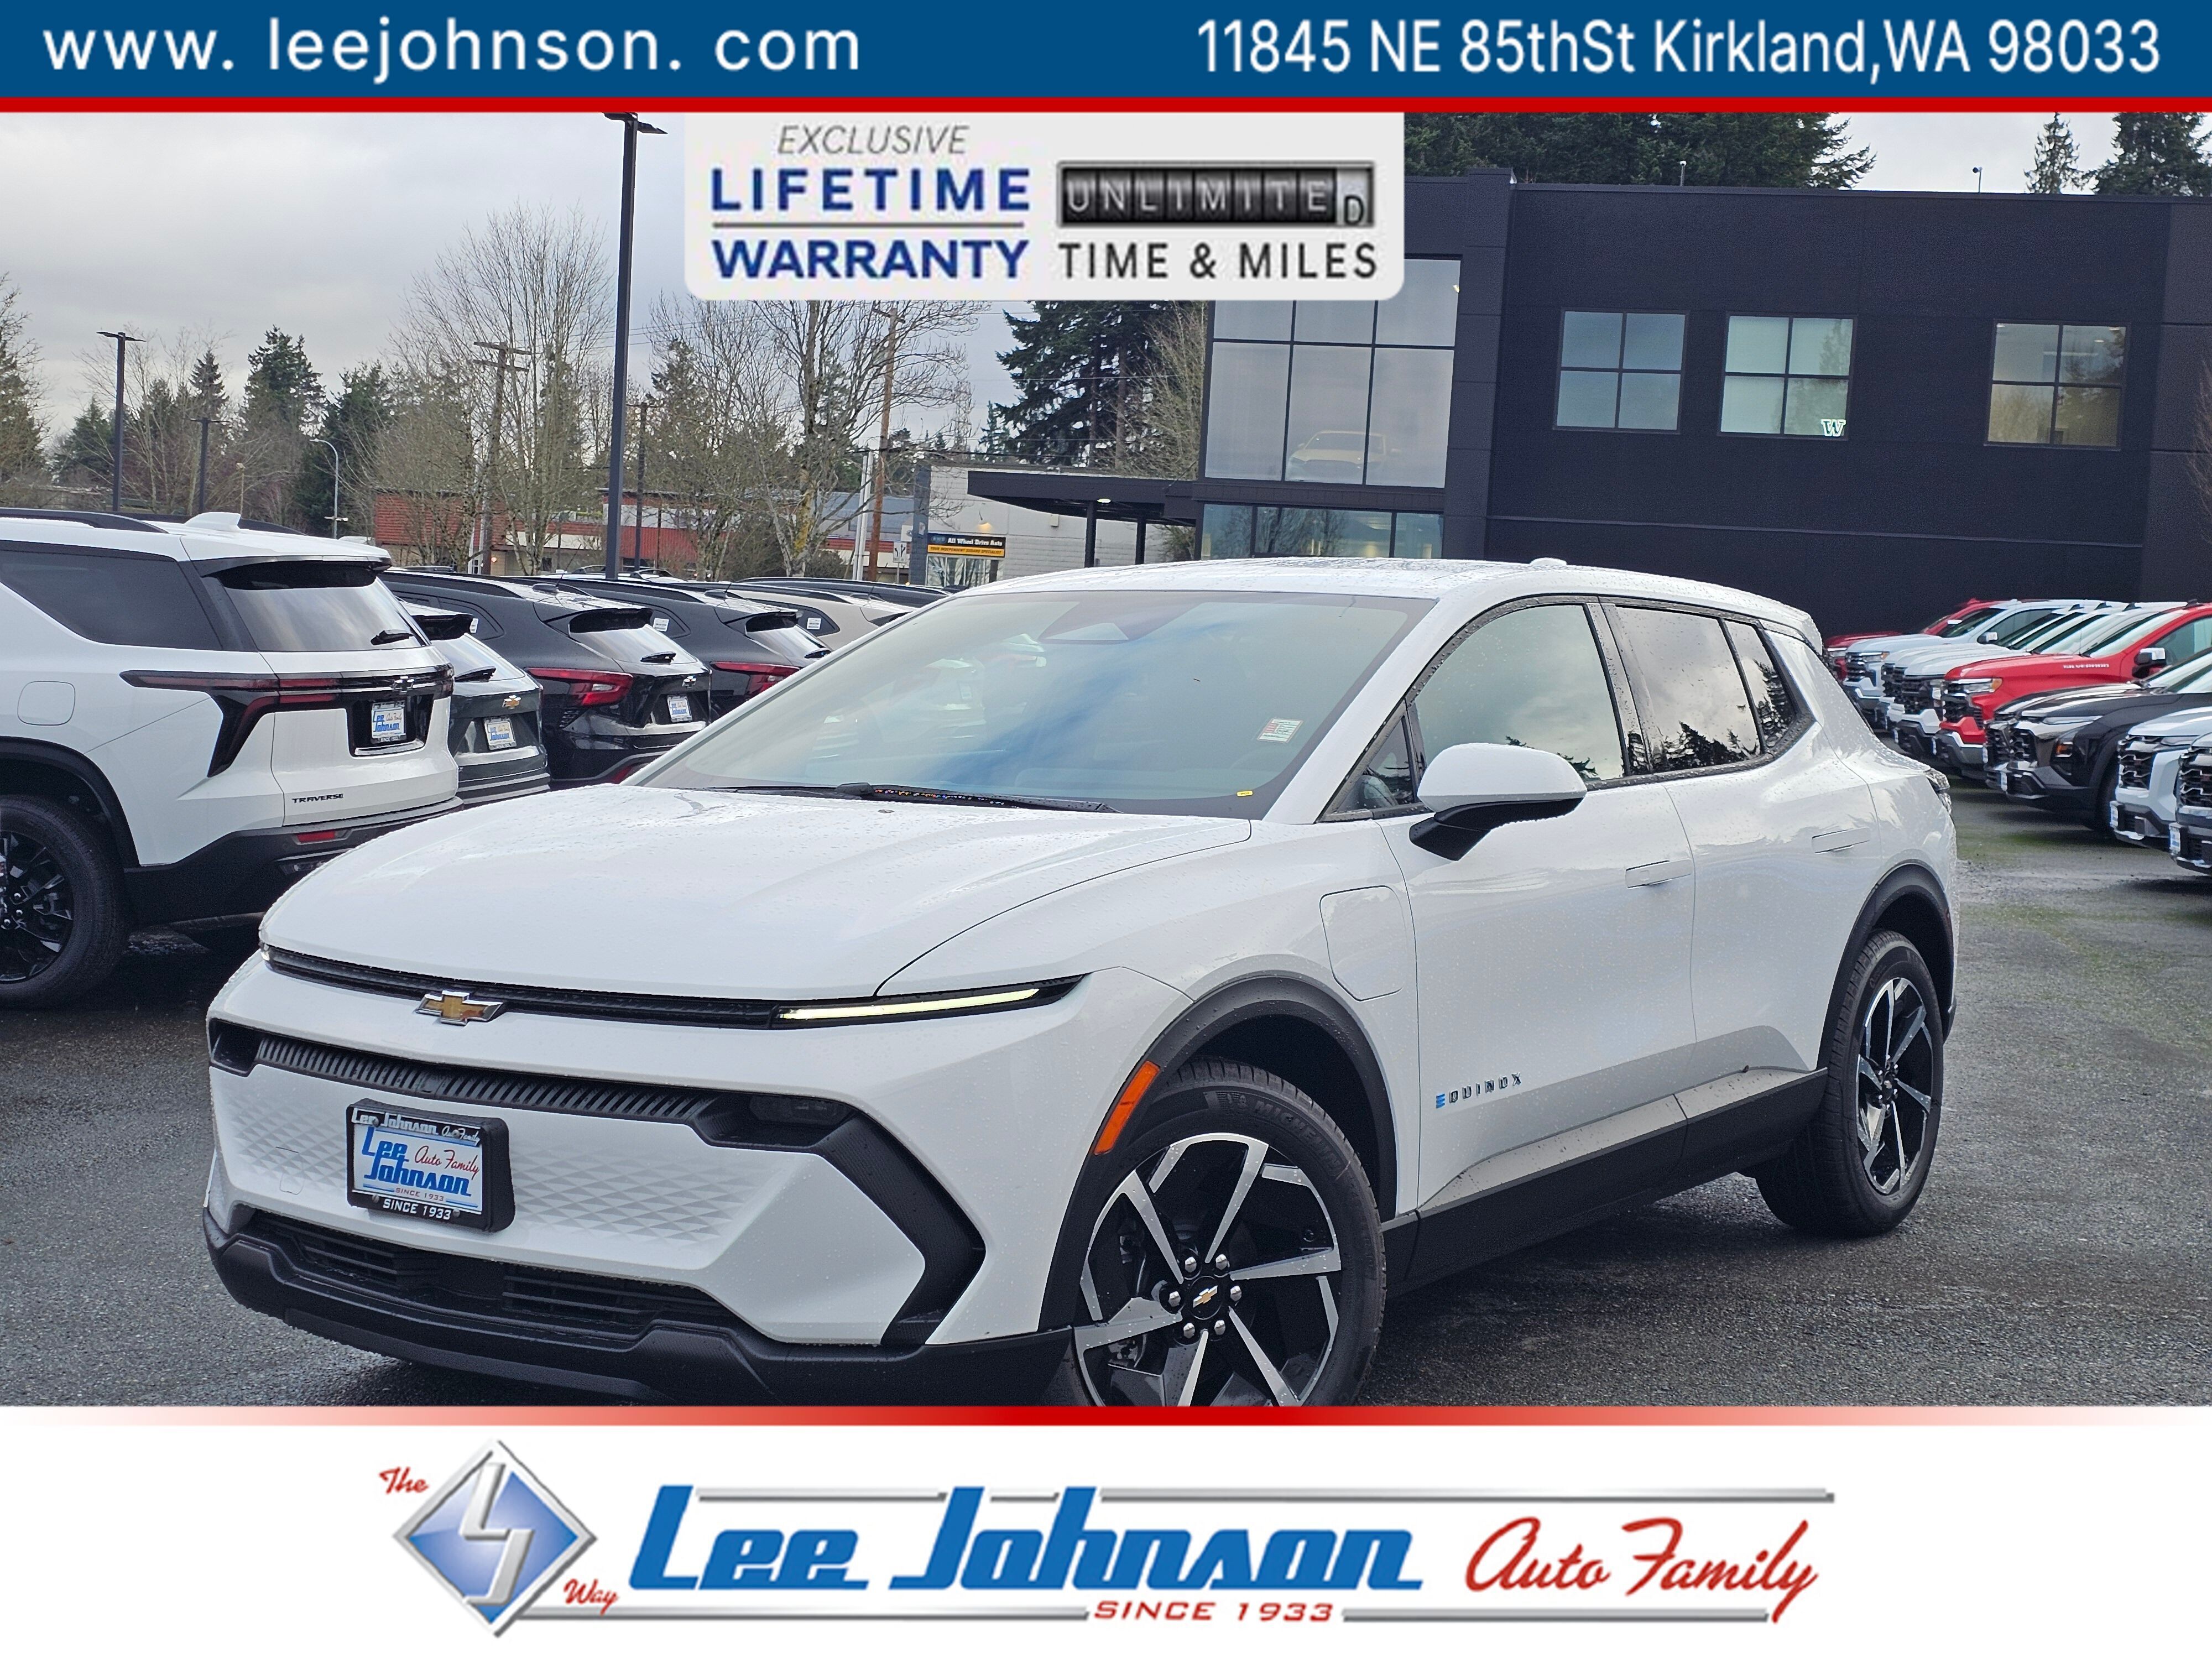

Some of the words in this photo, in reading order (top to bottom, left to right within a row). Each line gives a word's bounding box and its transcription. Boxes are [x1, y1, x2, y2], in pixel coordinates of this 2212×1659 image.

[1820, 419, 1846, 437] W
[292, 794, 344, 804] TRAVERSE
[1436, 1072, 1522, 1109] EQUINOX
[361, 1126, 409, 1162] Lee
[363, 1151, 472, 1197] Johnson
[415, 1145, 442, 1166] Auto
[444, 1149, 480, 1181] Family
[382, 1198, 419, 1214] SINCE
[422, 1206, 452, 1220] 1933
[395, 1187, 420, 1197] SINCE
[424, 1192, 444, 1202] 1933
